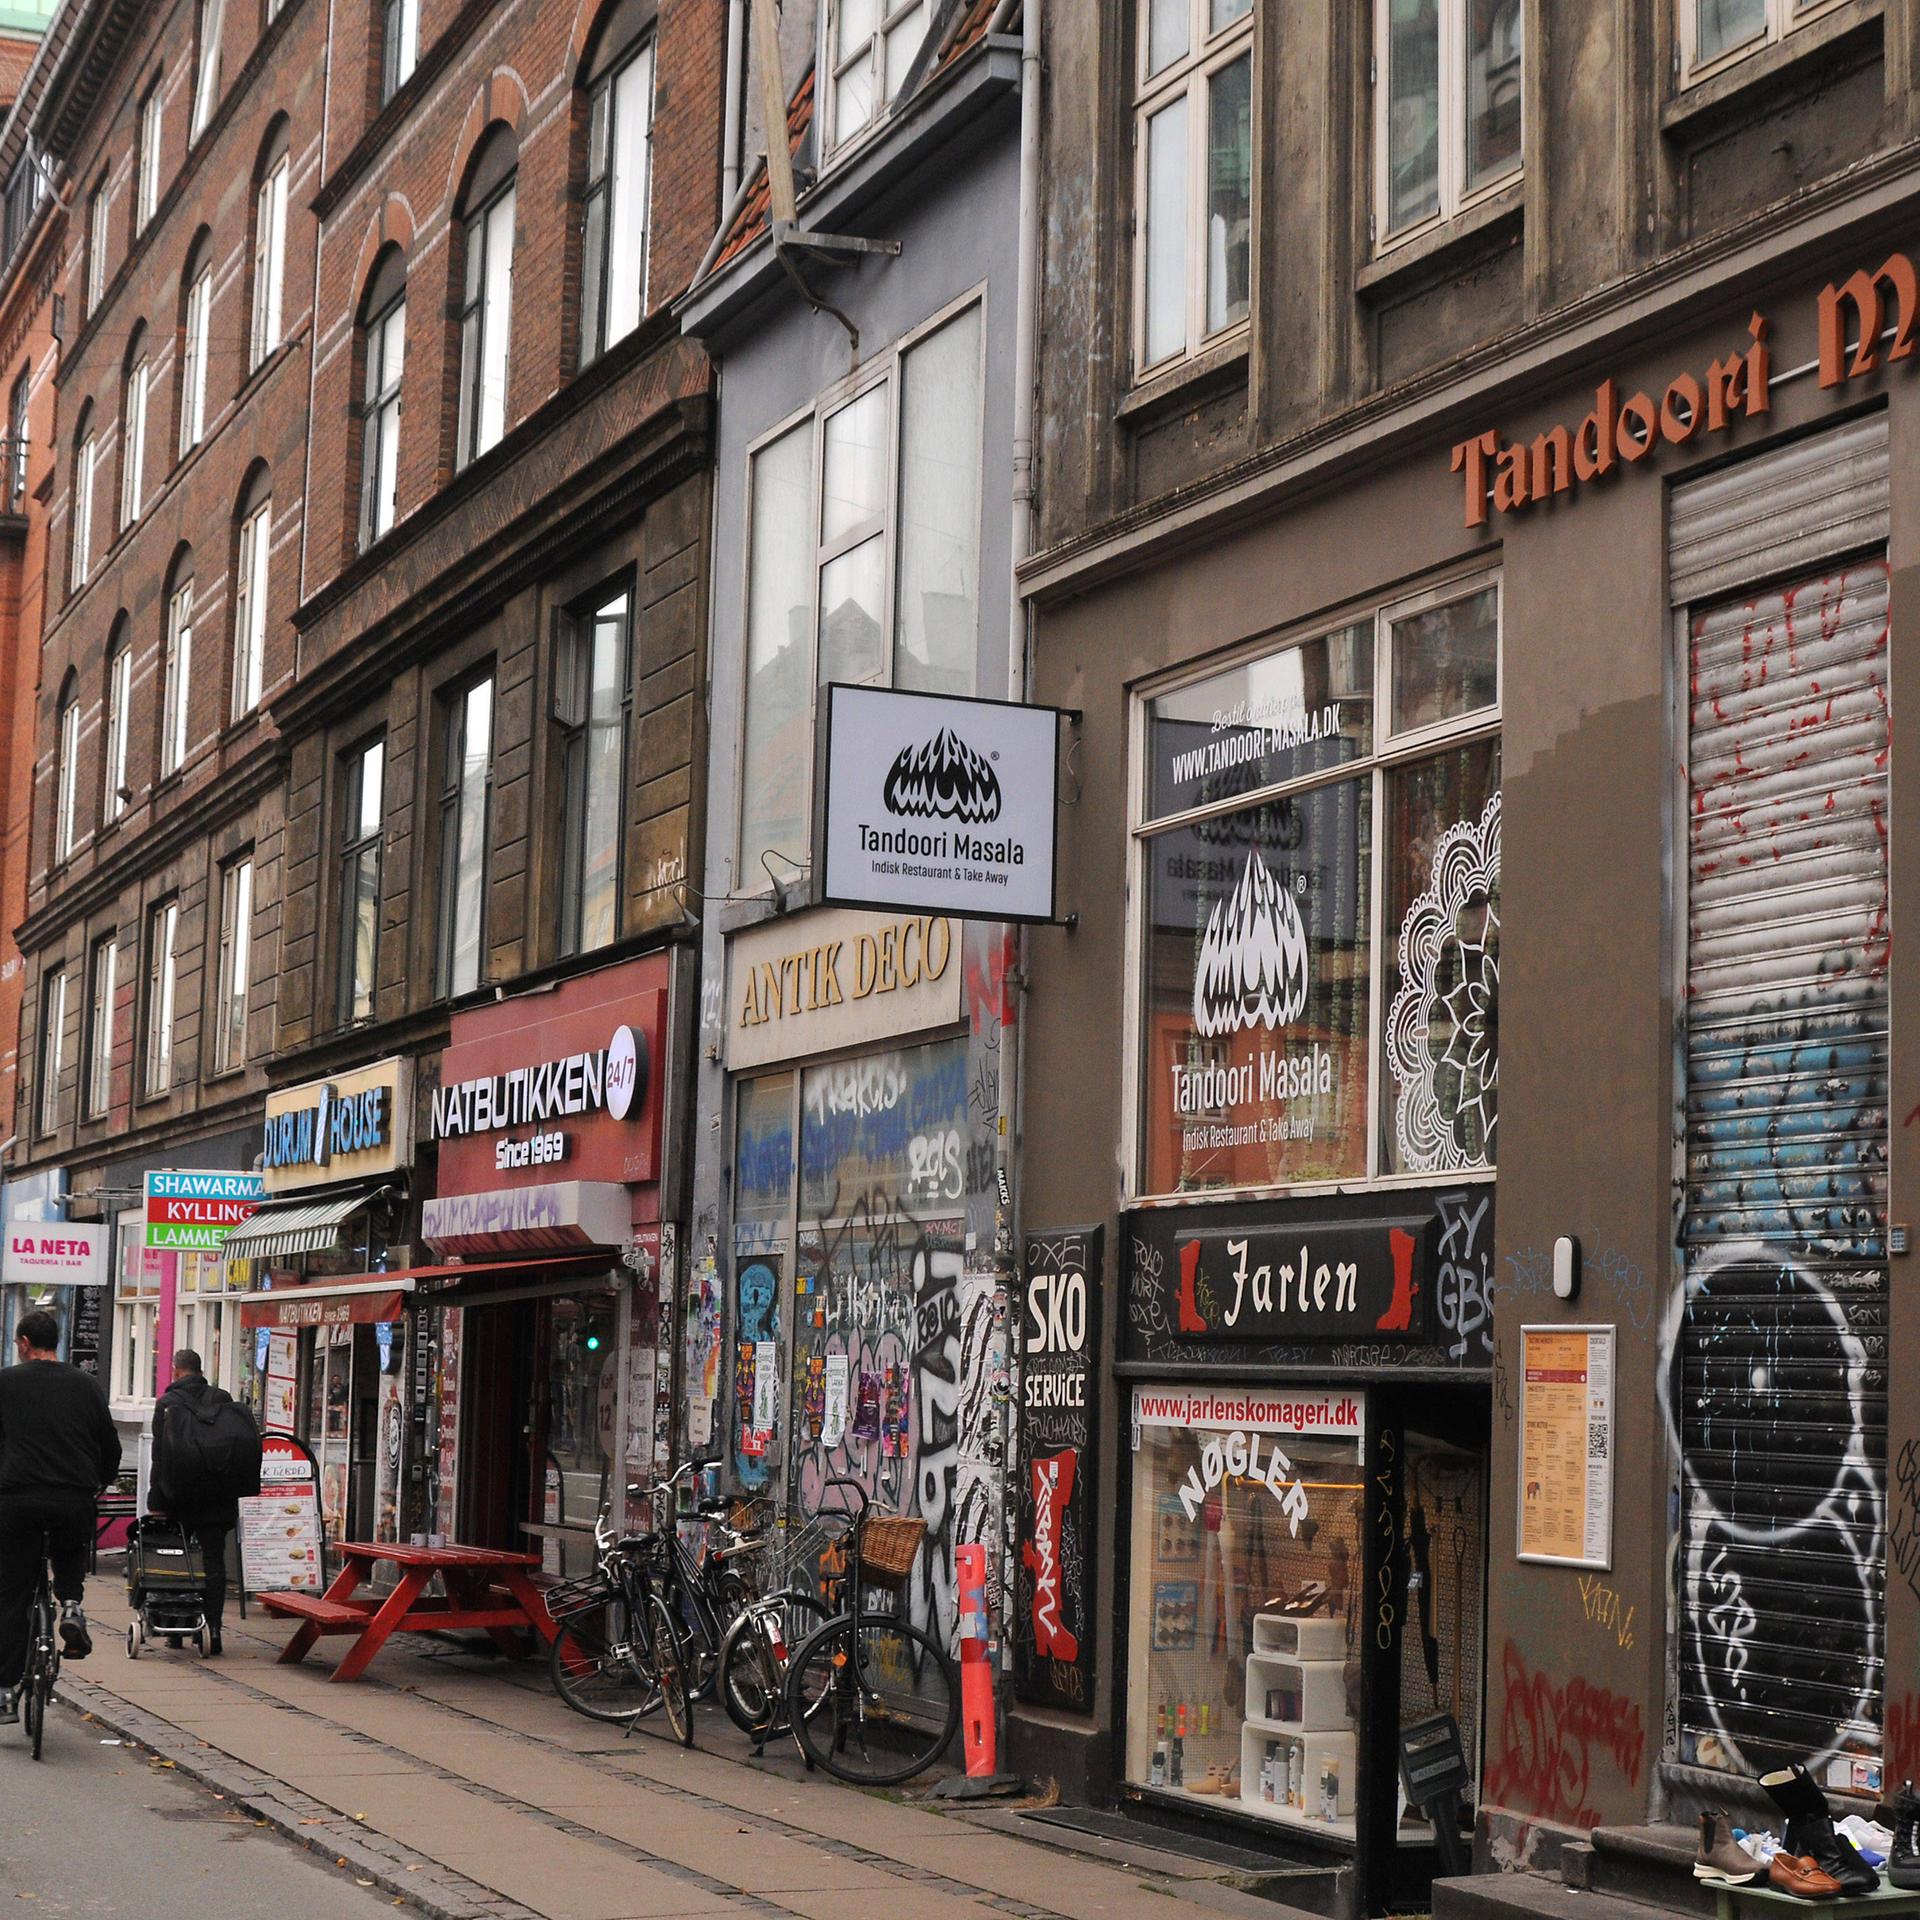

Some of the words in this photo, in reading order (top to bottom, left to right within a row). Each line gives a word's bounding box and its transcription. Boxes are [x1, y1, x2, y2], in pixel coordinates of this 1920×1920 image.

[1450, 310, 1770, 529] Tandoori
[1172, 702, 1341, 785] WWW.TANDOORI-MASALA.DK
[858, 824, 947, 858] Tandoori
[954, 833, 1024, 865] Masala
[872, 860, 900, 875] Indisk
[902, 863, 952, 880] Restaurant
[954, 867, 961, 880] &
[963, 868, 983, 882] Take
[985, 871, 1009, 886] Away
[740, 941, 843, 1027] ANTIK
[852, 916, 951, 999] DECO
[431, 1049, 604, 1139] NATBUTIKKEN
[606, 1055, 634, 1089] 24/7
[1171, 1053, 1253, 1113] Tandoori
[1260, 1043, 1332, 1101] Masala
[263, 1108, 313, 1168] DURUM
[330, 1087, 384, 1154] HOUSE
[495, 1137, 529, 1170] Since
[530, 1131, 564, 1165] 1969
[1182, 1124, 1209, 1152] Indisk
[1210, 1120, 1258, 1149] Restaurant
[1259, 1122, 1267, 1139] &
[1268, 1118, 1290, 1142] Take
[1290, 1116, 1316, 1143] Away
[153, 1175, 263, 1197] SHAWARMA
[167, 1201, 253, 1221] KYLLING
[12, 1237, 35, 1254] LA
[40, 1239, 91, 1256] NETA
[19, 1257, 59, 1267] TAQUERIA
[66, 1259, 82, 1267] BAR
[1223, 1239, 1357, 1328] Jarlen
[1027, 1272, 1087, 1353] SKO
[1140, 1394, 1359, 1431] www.jarlenskomageri.dk
[1178, 1431, 1309, 1539] NØGLER
